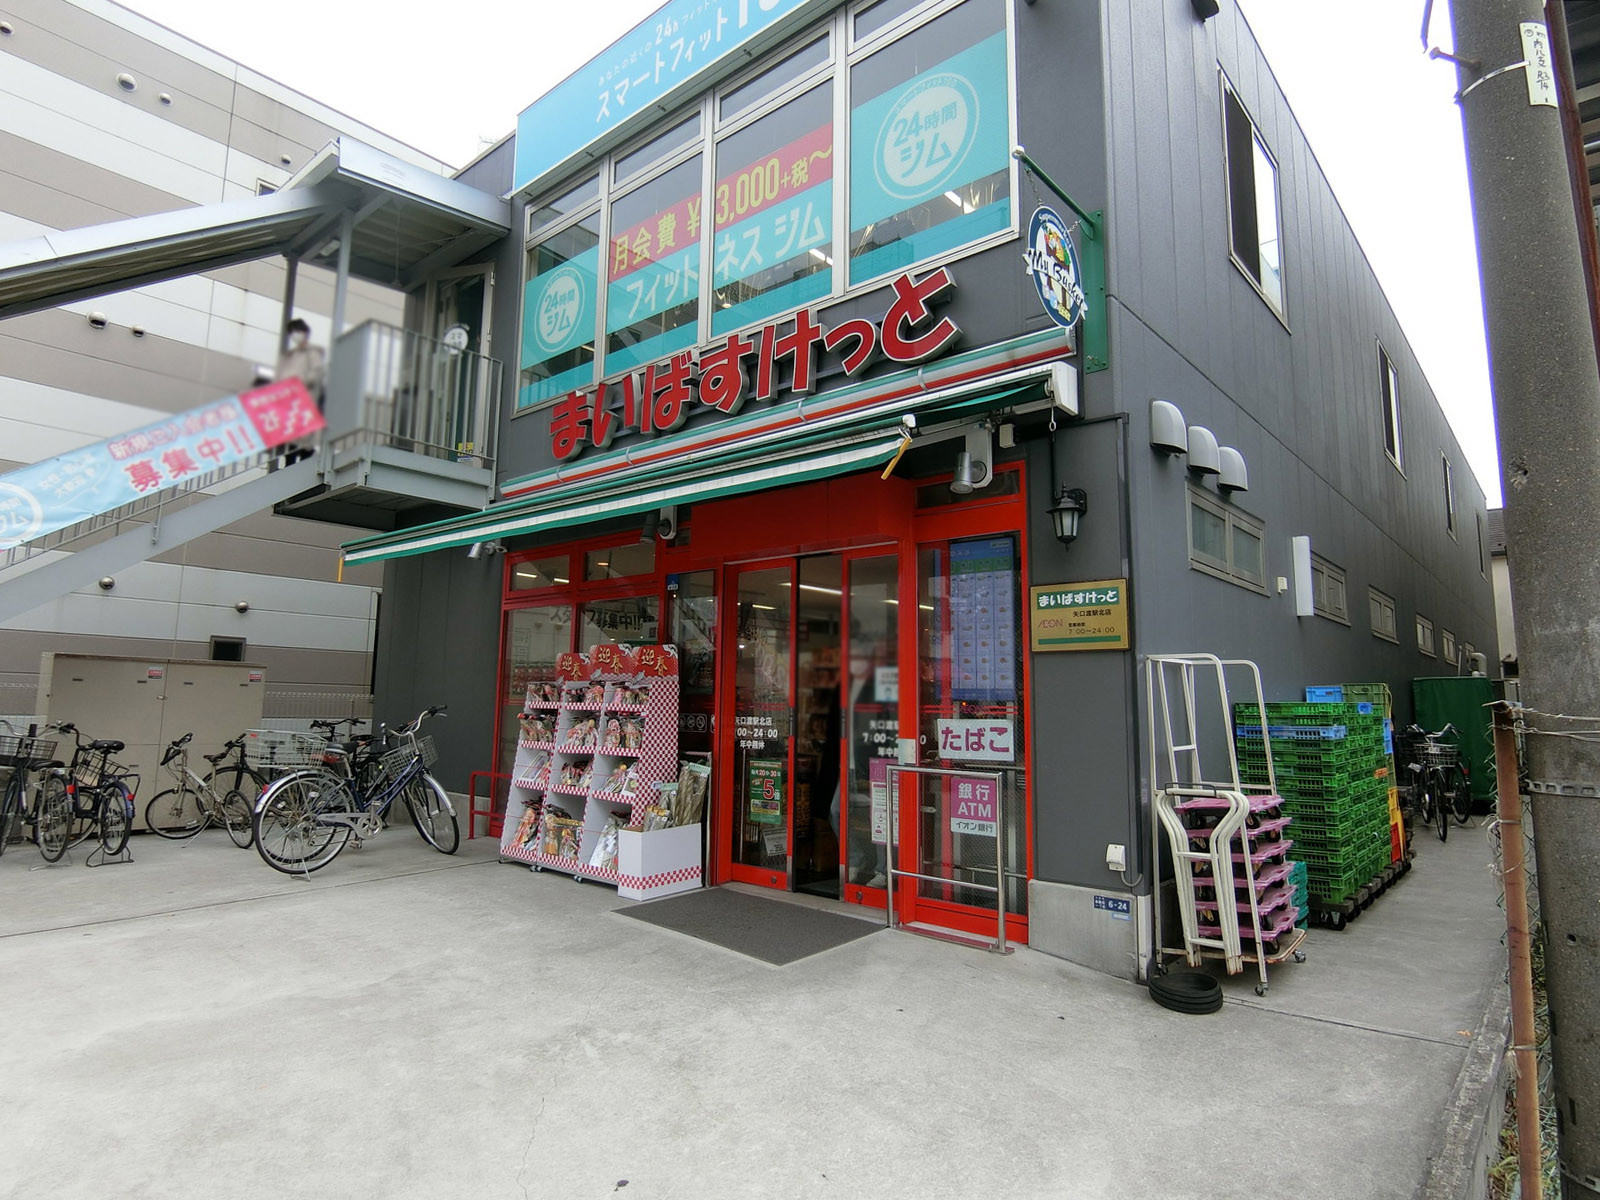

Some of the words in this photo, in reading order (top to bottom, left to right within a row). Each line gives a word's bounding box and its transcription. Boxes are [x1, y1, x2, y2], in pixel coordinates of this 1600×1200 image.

[596, 7, 729, 123] スマートフィット
[893, 101, 957, 148] 24時間
[900, 132, 952, 178] ジム
[546, 308, 572, 337] ジム
[549, 266, 960, 461] まいばすけっと
[1038, 590, 1118, 607] まいばすけっと
[1072, 608, 1112, 618] 矢口渡駅北店
[598, 647, 624, 675] 迎春
[641, 648, 668, 678] 迎春
[941, 726, 1010, 753] たばこ
[957, 782, 990, 801] 銀行
[957, 801, 992, 819] ATM
[955, 821, 993, 834] イオン銀行
[1107, 900, 1128, 911] 6-24
